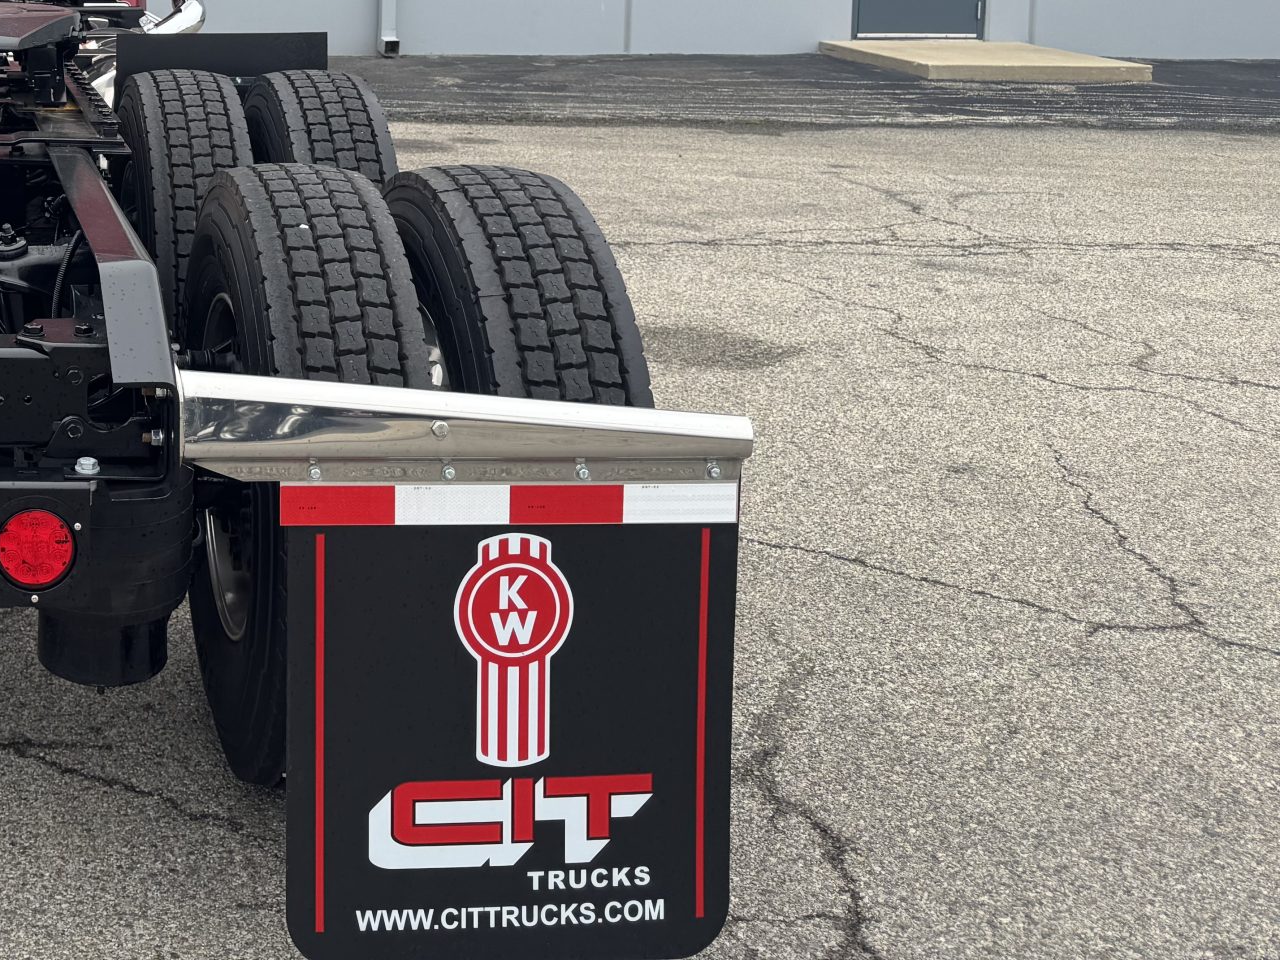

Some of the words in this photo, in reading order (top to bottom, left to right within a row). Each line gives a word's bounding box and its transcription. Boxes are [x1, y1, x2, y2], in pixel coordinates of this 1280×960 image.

[392, 773, 653, 846] CIT
[527, 866, 651, 891] TRUCKS
[356, 899, 665, 932] WWW.CITTRUCKS.COM
